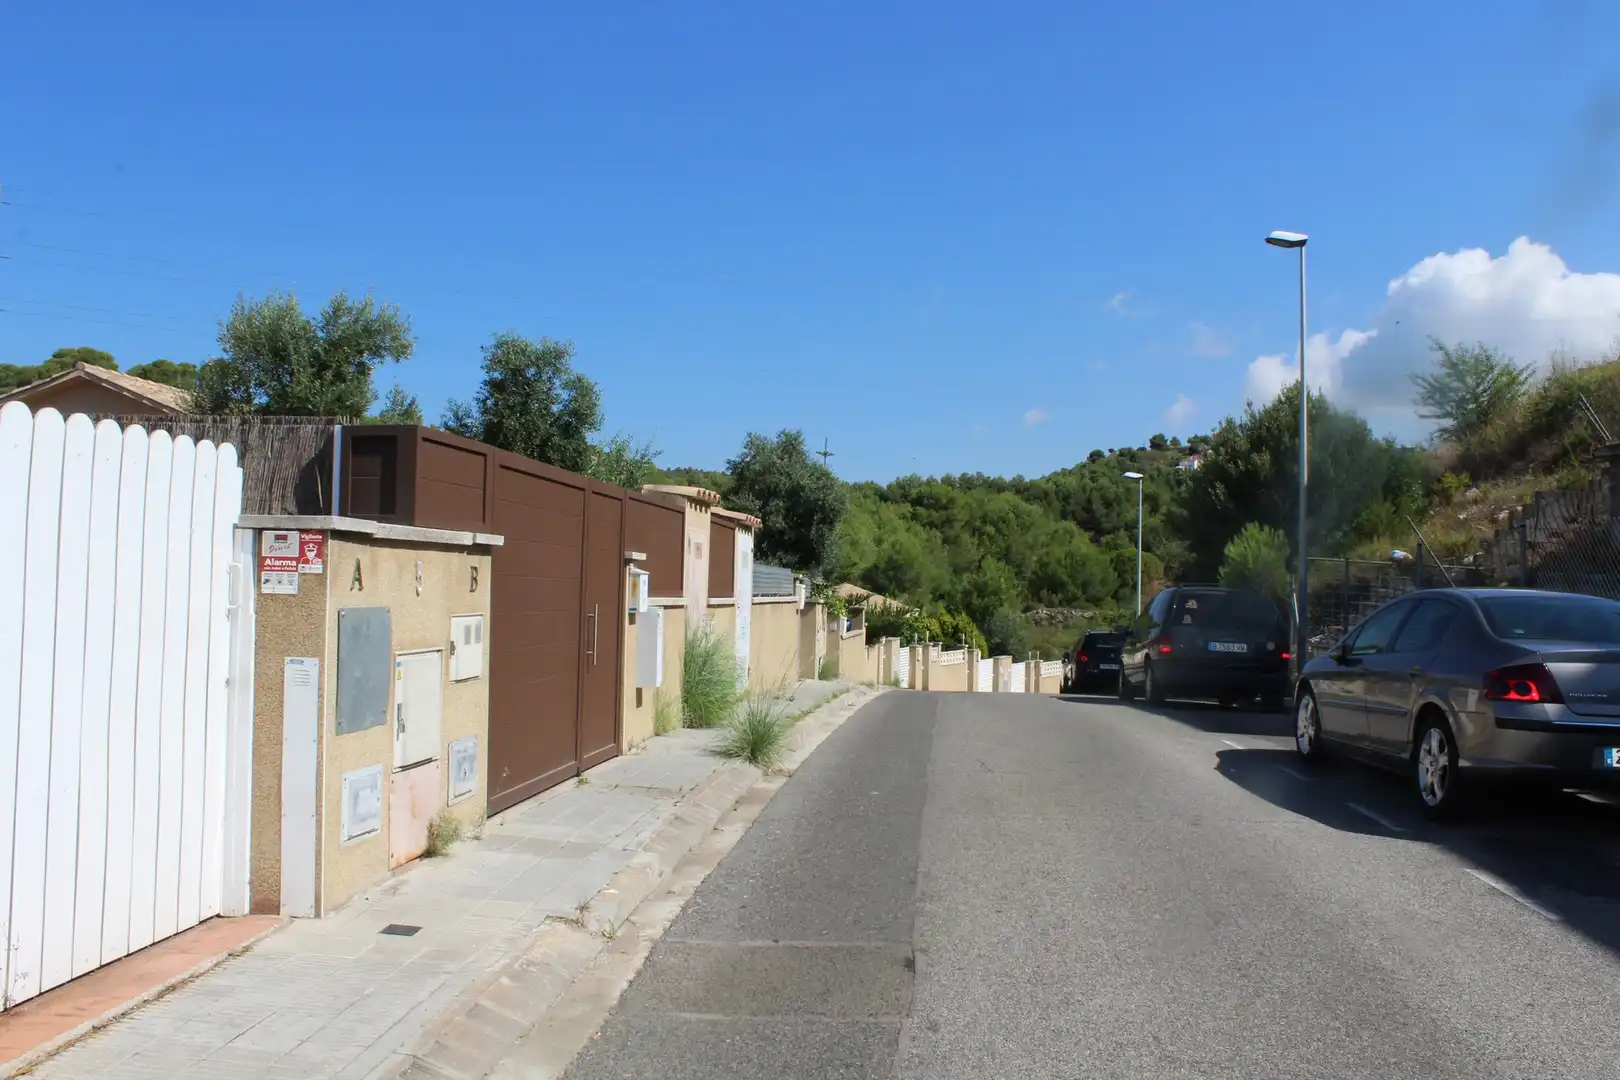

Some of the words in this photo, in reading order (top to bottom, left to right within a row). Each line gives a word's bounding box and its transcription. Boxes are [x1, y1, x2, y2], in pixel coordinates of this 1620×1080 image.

[264, 558, 296, 566] Alarma
[350, 558, 364, 592] A
[469, 566, 478, 592] B
